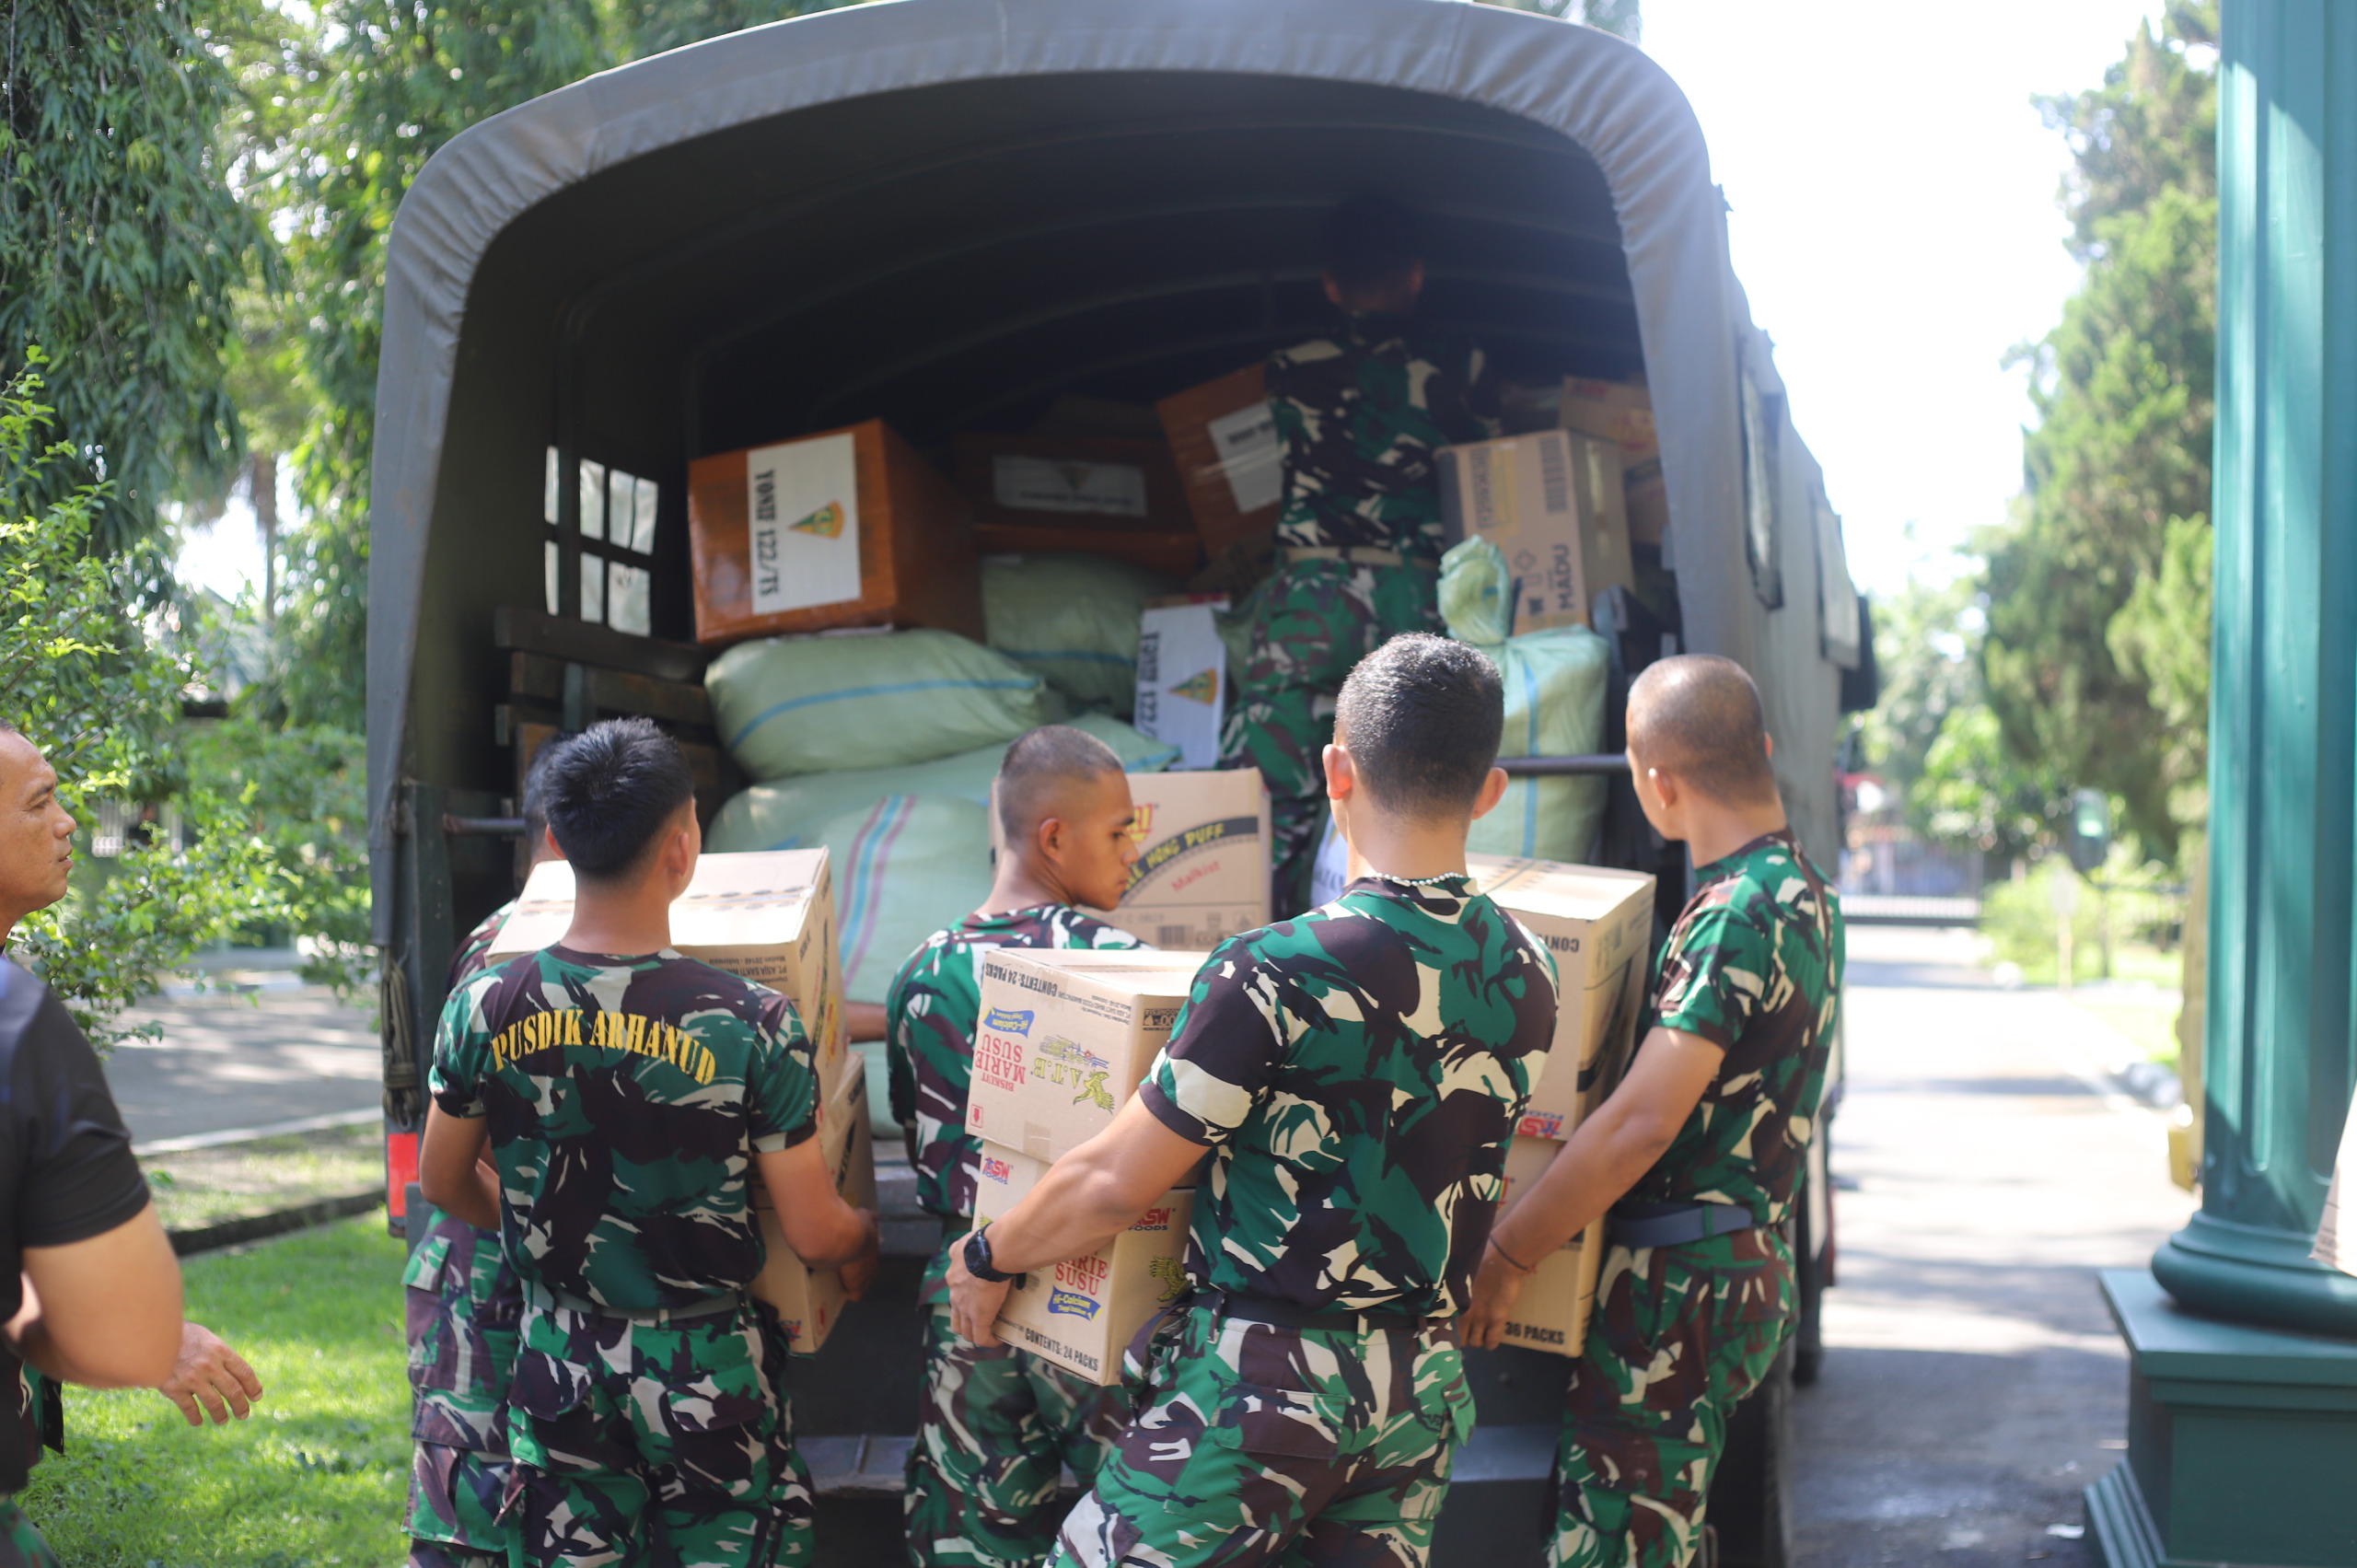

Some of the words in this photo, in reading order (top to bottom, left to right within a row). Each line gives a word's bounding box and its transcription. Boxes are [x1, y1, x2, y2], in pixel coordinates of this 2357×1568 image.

[1551, 543, 1574, 610] MADU
[1184, 822, 1225, 848] PUFF
[1539, 934, 1580, 954] CONT
[985, 963, 1007, 981] PACKS
[1007, 970, 1018, 984] 24
[1018, 973, 1058, 997] CONTENTS:
[492, 1009, 584, 1072] PUSDIK
[589, 1010, 715, 1086] ARHANUD
[981, 1034, 1023, 1063] SUSU
[975, 1051, 1027, 1085] MARIE
[981, 1073, 1015, 1093] BISKUIT
[1525, 1109, 1563, 1121] FOO
[982, 1170, 1008, 1185] FOODS
[1055, 1262, 1099, 1295] SUSU
[1505, 1321, 1522, 1338] 36
[1524, 1325, 1565, 1345] PACKS
[1025, 1327, 1062, 1355] CONTENTS:
[1063, 1345, 1073, 1361] 24
[1074, 1350, 1098, 1372] PACKS
